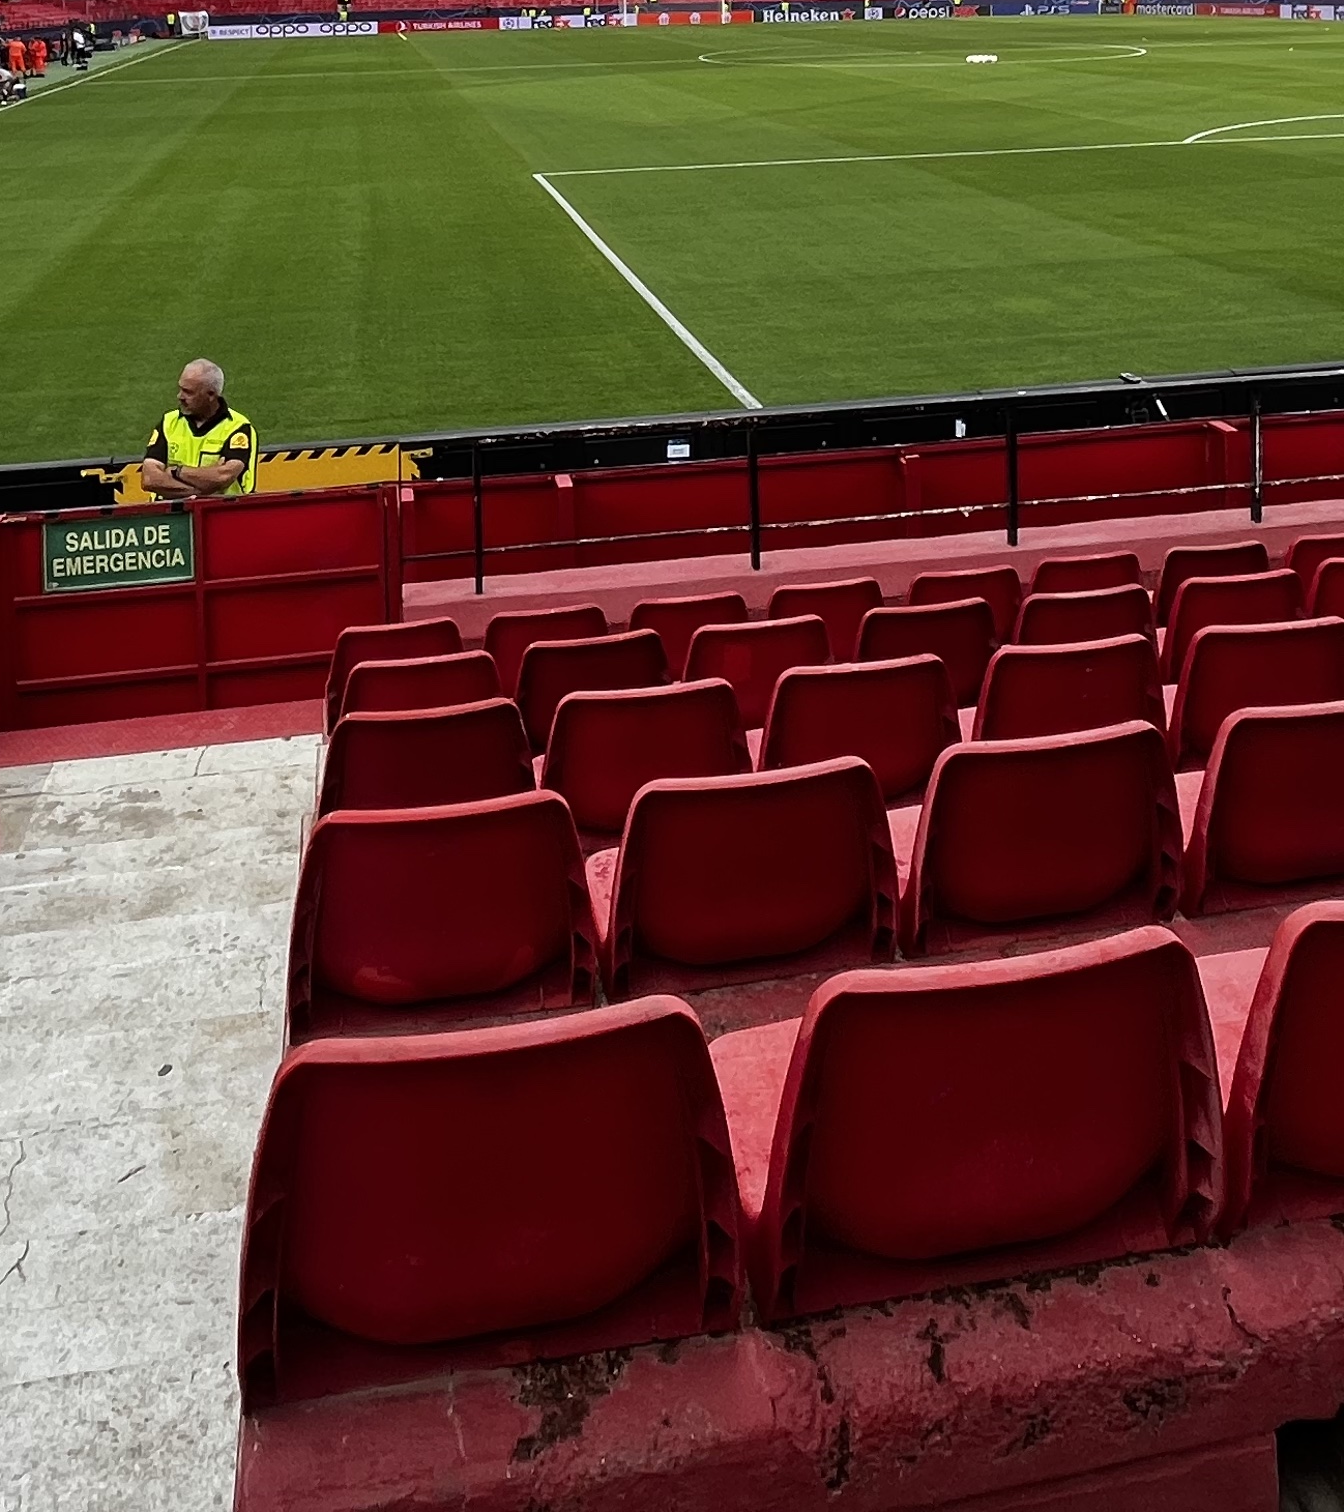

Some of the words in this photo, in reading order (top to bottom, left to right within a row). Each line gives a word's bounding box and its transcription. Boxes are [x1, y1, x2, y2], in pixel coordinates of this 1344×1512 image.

[762, 8, 840, 23] Heineken
[908, 5, 951, 20] pepsi
[1137, 3, 1193, 16] mastercard
[256, 24, 309, 38] oppo
[319, 22, 372, 37] oppo
[65, 527, 139, 552] SALIDA
[144, 524, 171, 546] DE
[53, 548, 185, 578] EMERGENCIA
